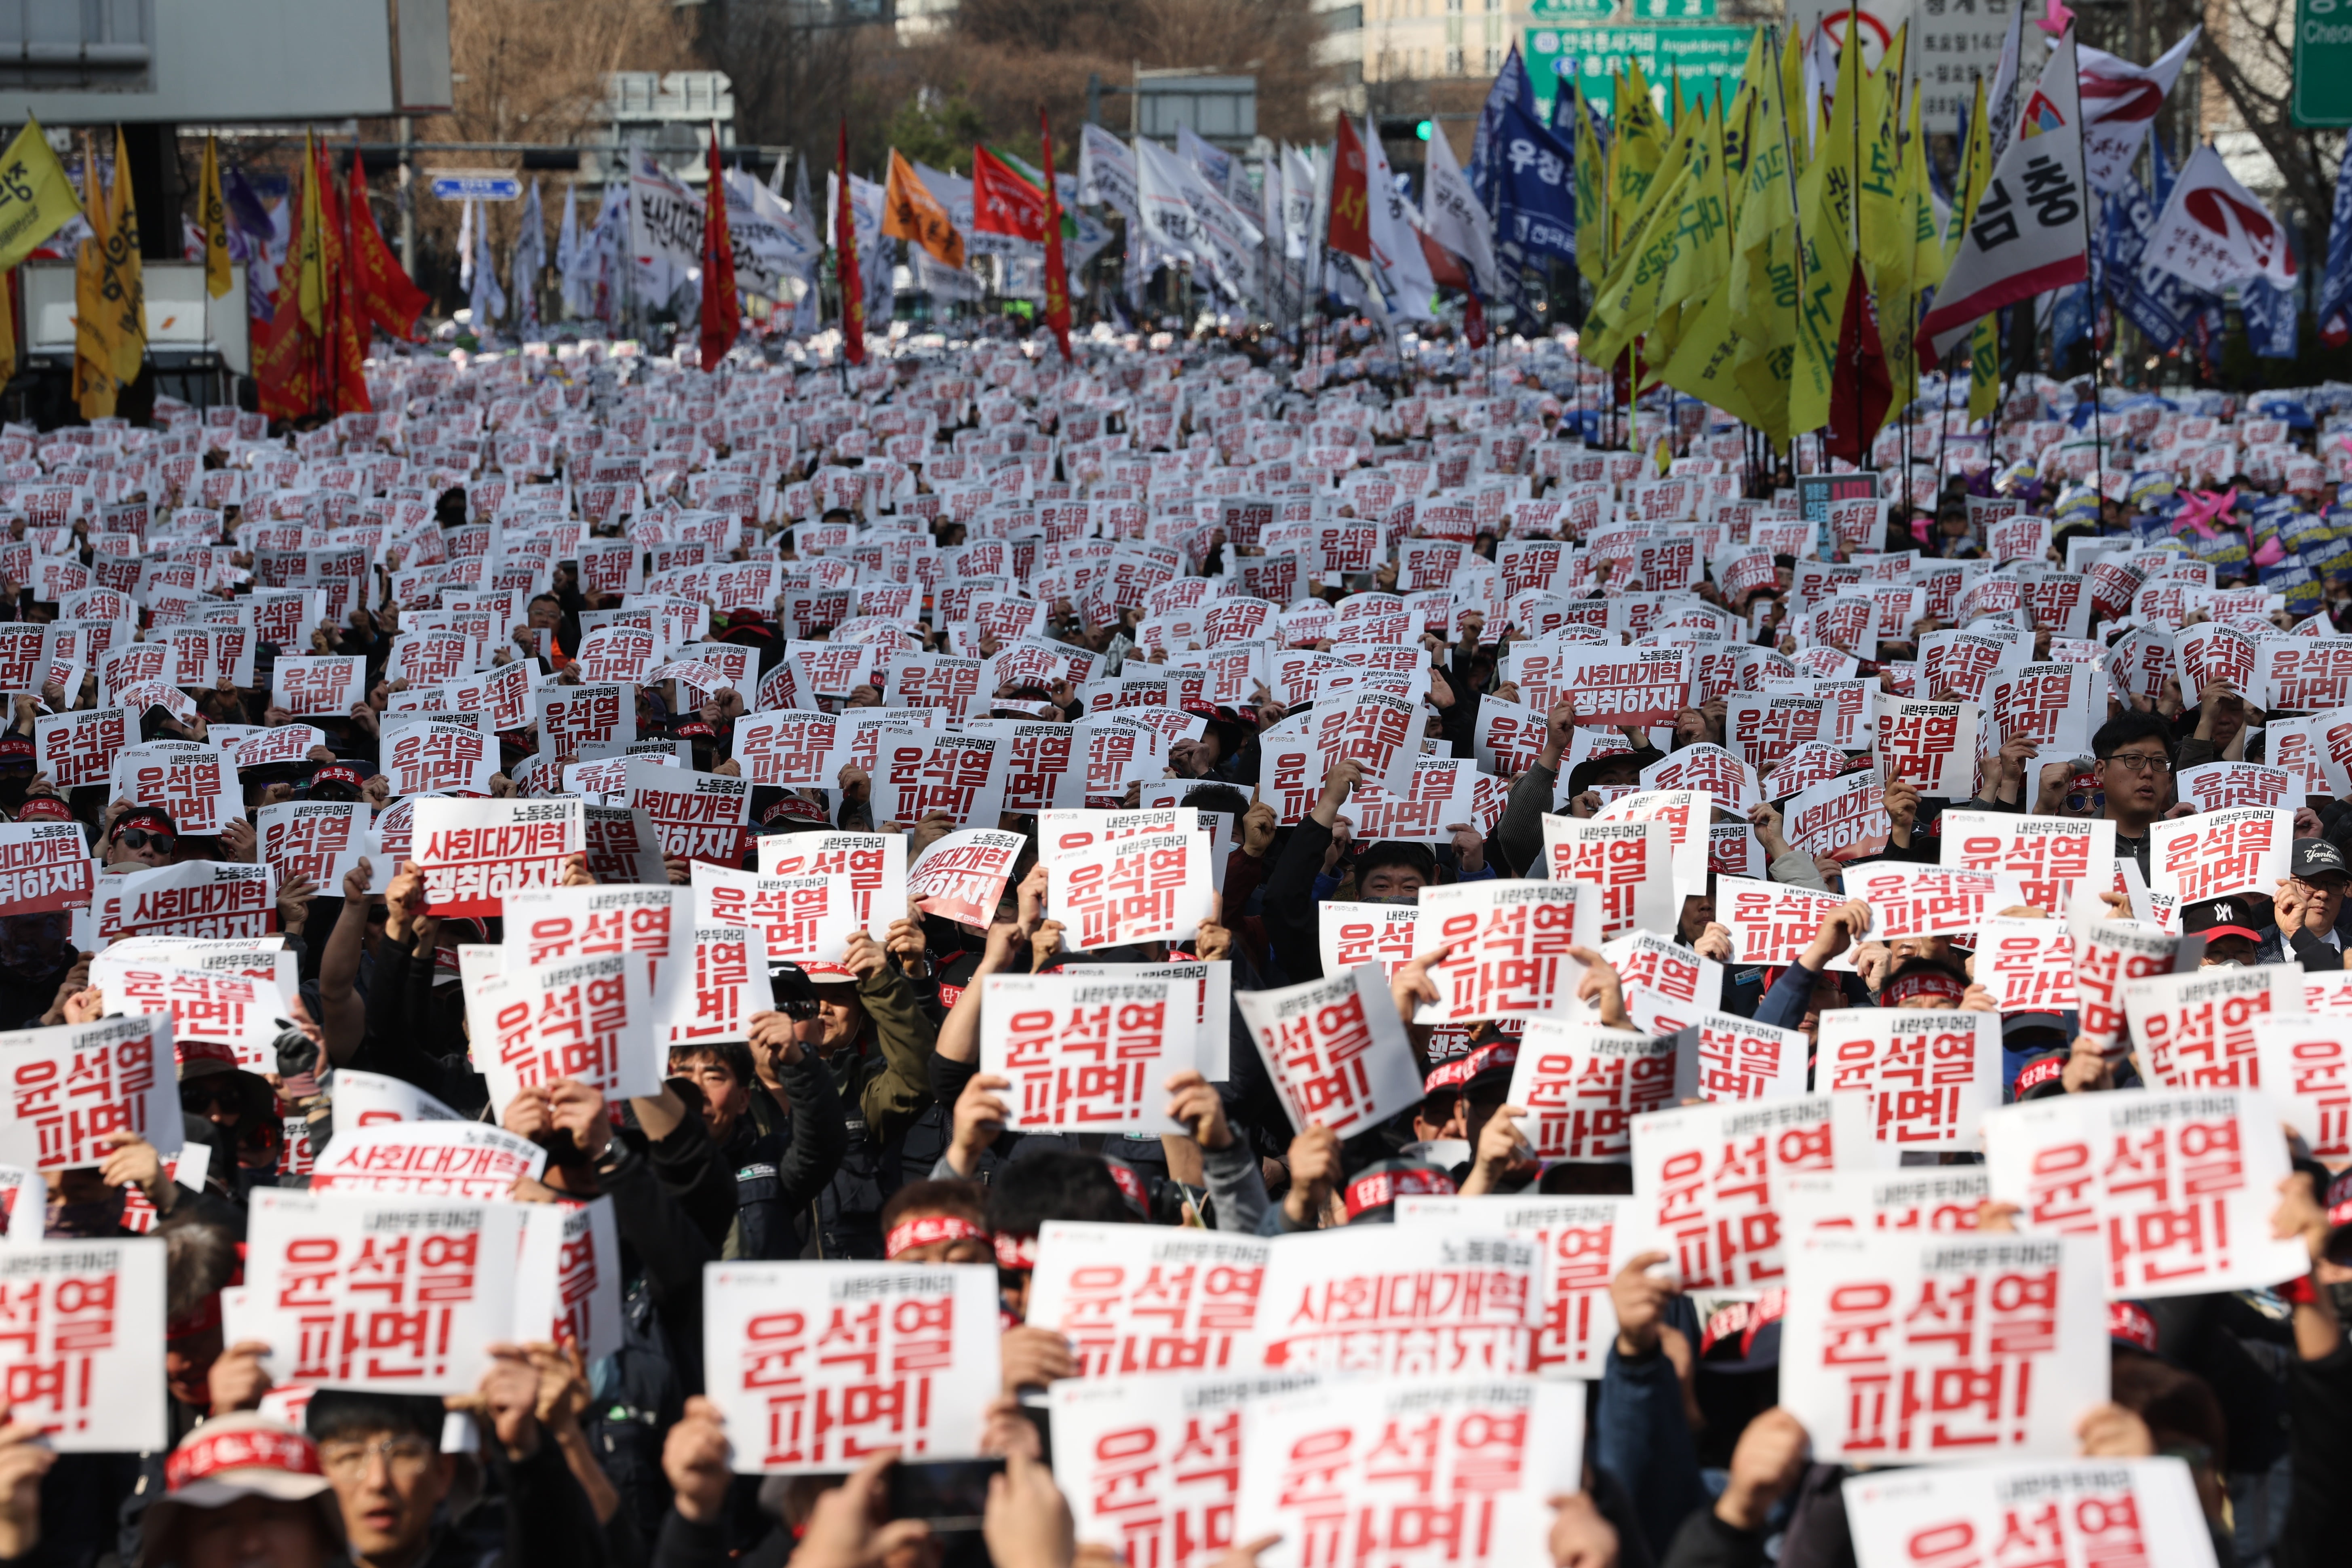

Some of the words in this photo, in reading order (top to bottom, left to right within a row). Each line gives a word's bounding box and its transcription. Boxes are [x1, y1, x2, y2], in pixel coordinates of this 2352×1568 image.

[1321, 529, 1376, 550] 윤석열
[585, 550, 633, 569] 윤석열
[1326, 550, 1370, 571] 파면!
[1409, 550, 1461, 571] 윤석열
[1502, 550, 1559, 574] 윤석열
[1641, 547, 1694, 568] 윤석열
[1646, 568, 1688, 590] 파면!
[267, 594, 302, 603] 내란우두머리
[1001, 597, 1037, 607] 내란우두머리
[2023, 583, 2080, 608] 윤석열
[792, 599, 849, 619] 윤석열
[975, 601, 1034, 625] 윤석열
[1203, 605, 1267, 630] 윤석열
[1, 625, 44, 634] 내란우두머리
[428, 633, 466, 641] 내란우두머리
[613, 630, 653, 640] 내란우두머리
[2213, 627, 2256, 648] 내란우두머리
[582, 638, 651, 660] 윤석열
[1374, 646, 1418, 654] 내란우두머리
[1955, 634, 2004, 649] 내란우두머리
[314, 658, 354, 666] 내란우두머리
[402, 642, 466, 665] 윤석열
[935, 659, 981, 668] 내란우두머리
[1055, 646, 1095, 660] 내란우두머리
[1209, 649, 1250, 659] 내란우두머리
[1640, 649, 1682, 662] 노동중심
[1924, 643, 2001, 678] 윤석열
[2183, 637, 2254, 670] 윤석열
[283, 664, 353, 691] 윤석열
[407, 660, 457, 683] 파면!
[486, 661, 525, 681] 내란우두머리
[586, 656, 643, 681] 파면!
[1163, 670, 1206, 679] 내란우두머리
[1363, 671, 1410, 679] 내란우두머리
[1573, 662, 1681, 687] 사회대개혁
[2019, 665, 2073, 677] 내란우두머리
[457, 668, 527, 711] 윤석열
[898, 668, 979, 696] 윤석열
[1122, 682, 1168, 691] 내란우두머리
[2276, 677, 2348, 708] 파면!
[291, 691, 343, 714] 파면!
[572, 687, 620, 700] 내란우두머리
[1323, 698, 1340, 706] 민주노총
[1357, 693, 1414, 714] 내란우두머리
[1575, 688, 1681, 715] 쟁취하자!
[1770, 698, 1823, 709] 내란우두머리
[1994, 675, 2072, 716] 윤석열
[77, 708, 124, 724] 내란우두머리
[546, 696, 619, 728] 윤석열
[784, 713, 836, 724] 내란우두머리
[886, 710, 933, 719] 내란우두머리
[1901, 704, 1960, 716] 내란우두머리
[2318, 712, 2337, 721] 민주노총
[431, 726, 484, 740] 내란우두머리
[1015, 726, 1074, 737] 내란우두머리
[1318, 705, 1410, 750] 윤석열
[1737, 708, 1822, 740] 윤석열
[1878, 714, 1957, 754] 윤석열
[11, 741, 31, 752] 투쟁
[46, 718, 126, 759] 윤석열
[626, 743, 676, 755] 내란우두머리
[743, 722, 835, 755] 윤석열
[935, 736, 995, 751] 내란우두머리
[171, 753, 218, 764] 내란우두머리
[239, 746, 302, 763] 파면!
[392, 736, 483, 768] 윤석열
[1691, 747, 1743, 766] 내란우두머리
[333, 766, 355, 779] 투쟁
[399, 761, 473, 795] 파면!
[752, 751, 824, 784] 파면!
[890, 747, 993, 787] 윤석열
[1655, 757, 1746, 790] 윤석열
[2231, 764, 2287, 782] 내란우두머리
[137, 764, 221, 803] 윤석열
[695, 778, 747, 795] 노동중심
[2192, 770, 2287, 797] 윤석열
[51, 806, 69, 817] 투쟁
[294, 805, 353, 818] 내란우두머리
[513, 801, 565, 820] 노동중심
[631, 788, 743, 824] 사회대개혁
[895, 784, 975, 823] 파면!
[1107, 811, 1176, 827] 내란우두머리
[1358, 799, 1442, 837] 파면!
[2017, 822, 2091, 834] 내란우두머리
[2211, 811, 2274, 826] 내란우두머리
[32, 826, 77, 838] 노동중심
[266, 817, 351, 862] 윤석열
[425, 825, 565, 860] 사회대개혁
[970, 834, 1020, 848] 노동중심
[1580, 825, 1647, 839] 내란우두머리
[2167, 820, 2272, 867] 윤석열
[2322, 843, 2335, 852] YORK
[1960, 837, 2089, 878] 윤석열
[2304, 849, 2340, 863] Yankees
[215, 866, 266, 881] 노동중심
[758, 877, 828, 889] 내란우두머리
[1067, 847, 1186, 906] 윤석열
[2178, 852, 2257, 900] 파면!
[133, 880, 266, 921] 사회대개혁
[711, 887, 828, 925] 윤석열
[1080, 889, 1173, 947] 파면!
[1884, 894, 1984, 936] 파면!
[1439, 903, 1574, 967] 윤석열
[1450, 957, 1557, 1018] 파면!
[497, 974, 627, 1064] 윤석열
[1007, 1002, 1164, 1067] 윤석열
[1833, 1031, 1975, 1089] 윤석열
[14, 1037, 155, 1119] 윤석열
[1020, 1060, 1144, 1126] 파면!
[2030, 1115, 2244, 1226] 윤석열
[278, 1232, 481, 1309] 윤석열
[1060, 1266, 1264, 1330] 윤석열
[1823, 1267, 2059, 1368] 윤석열
[294, 1307, 452, 1381] 파면!
[742, 1297, 954, 1392] 윤석열
[1842, 1355, 2030, 1452] 파면!
[762, 1370, 933, 1468] 파면!
[1278, 1408, 1527, 1510] 윤석열
